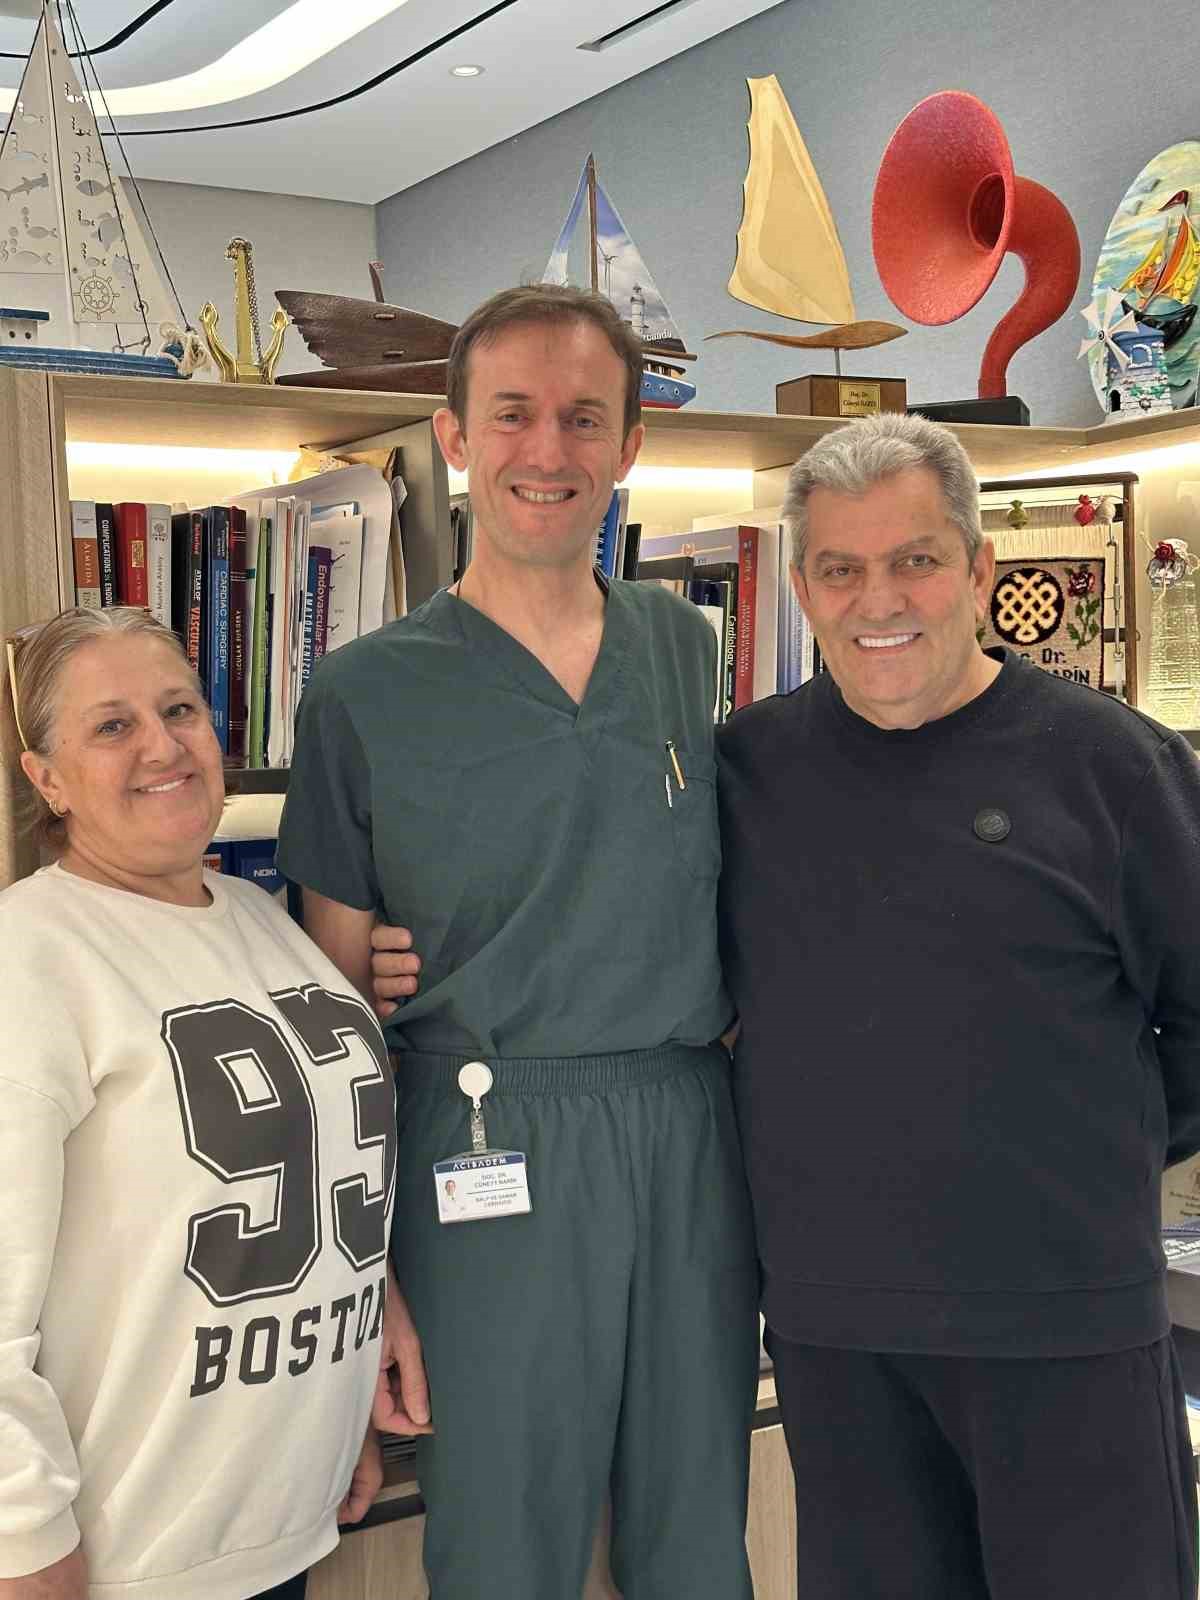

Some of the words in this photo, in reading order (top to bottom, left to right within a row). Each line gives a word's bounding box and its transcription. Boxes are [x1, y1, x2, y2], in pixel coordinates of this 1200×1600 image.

[83, 542, 96, 584] ALMEIDA
[102, 520, 112, 576] COMPLICATIONS
[105, 583, 113, 606] ENDOV
[194, 592, 201, 601] OF
[220, 571, 229, 617] CARDIAC
[315, 564, 327, 641] Endovascular
[190, 608, 201, 657] VASCULAR
[219, 620, 228, 669] SURGERY
[235, 609, 243, 641] SURGERY
[727, 615, 737, 666] Cardiology
[1042, 647, 1067, 664] Dr.
[161, 983, 397, 1307] 93
[453, 1156, 507, 1171] ACIBADEM
